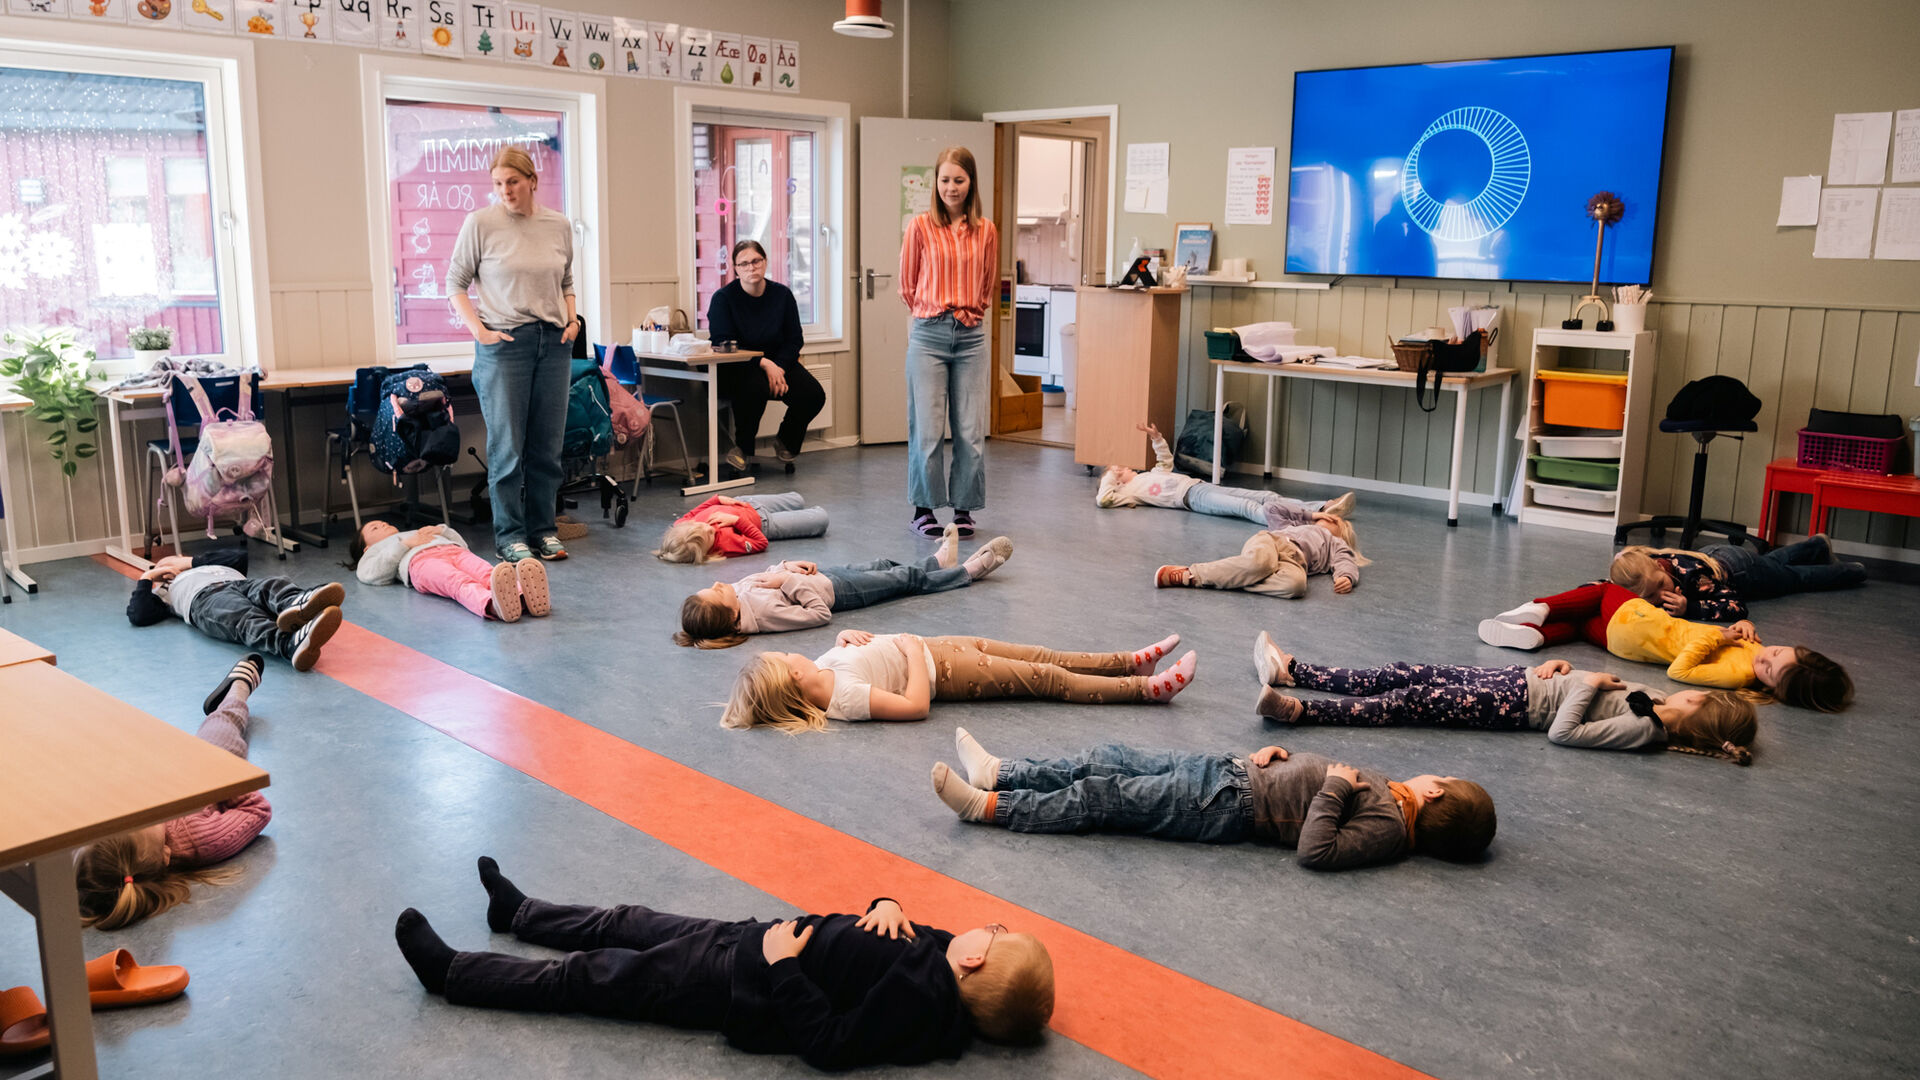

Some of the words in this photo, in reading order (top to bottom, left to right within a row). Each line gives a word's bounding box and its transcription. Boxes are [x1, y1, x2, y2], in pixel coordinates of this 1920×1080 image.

[293, 0, 321, 13] p
[340, 0, 371, 22] Qq
[386, 0, 412, 18] Rr
[429, 1, 454, 25] Ss
[472, 4, 494, 28] Tt
[549, 17, 571, 40] Vv
[582, 21, 610, 42] Ww
[654, 31, 674, 56] Yy
[687, 37, 706, 57] Zz
[715, 40, 740, 58] Ææ
[747, 44, 767, 64] Øø
[777, 44, 796, 67] Åå
